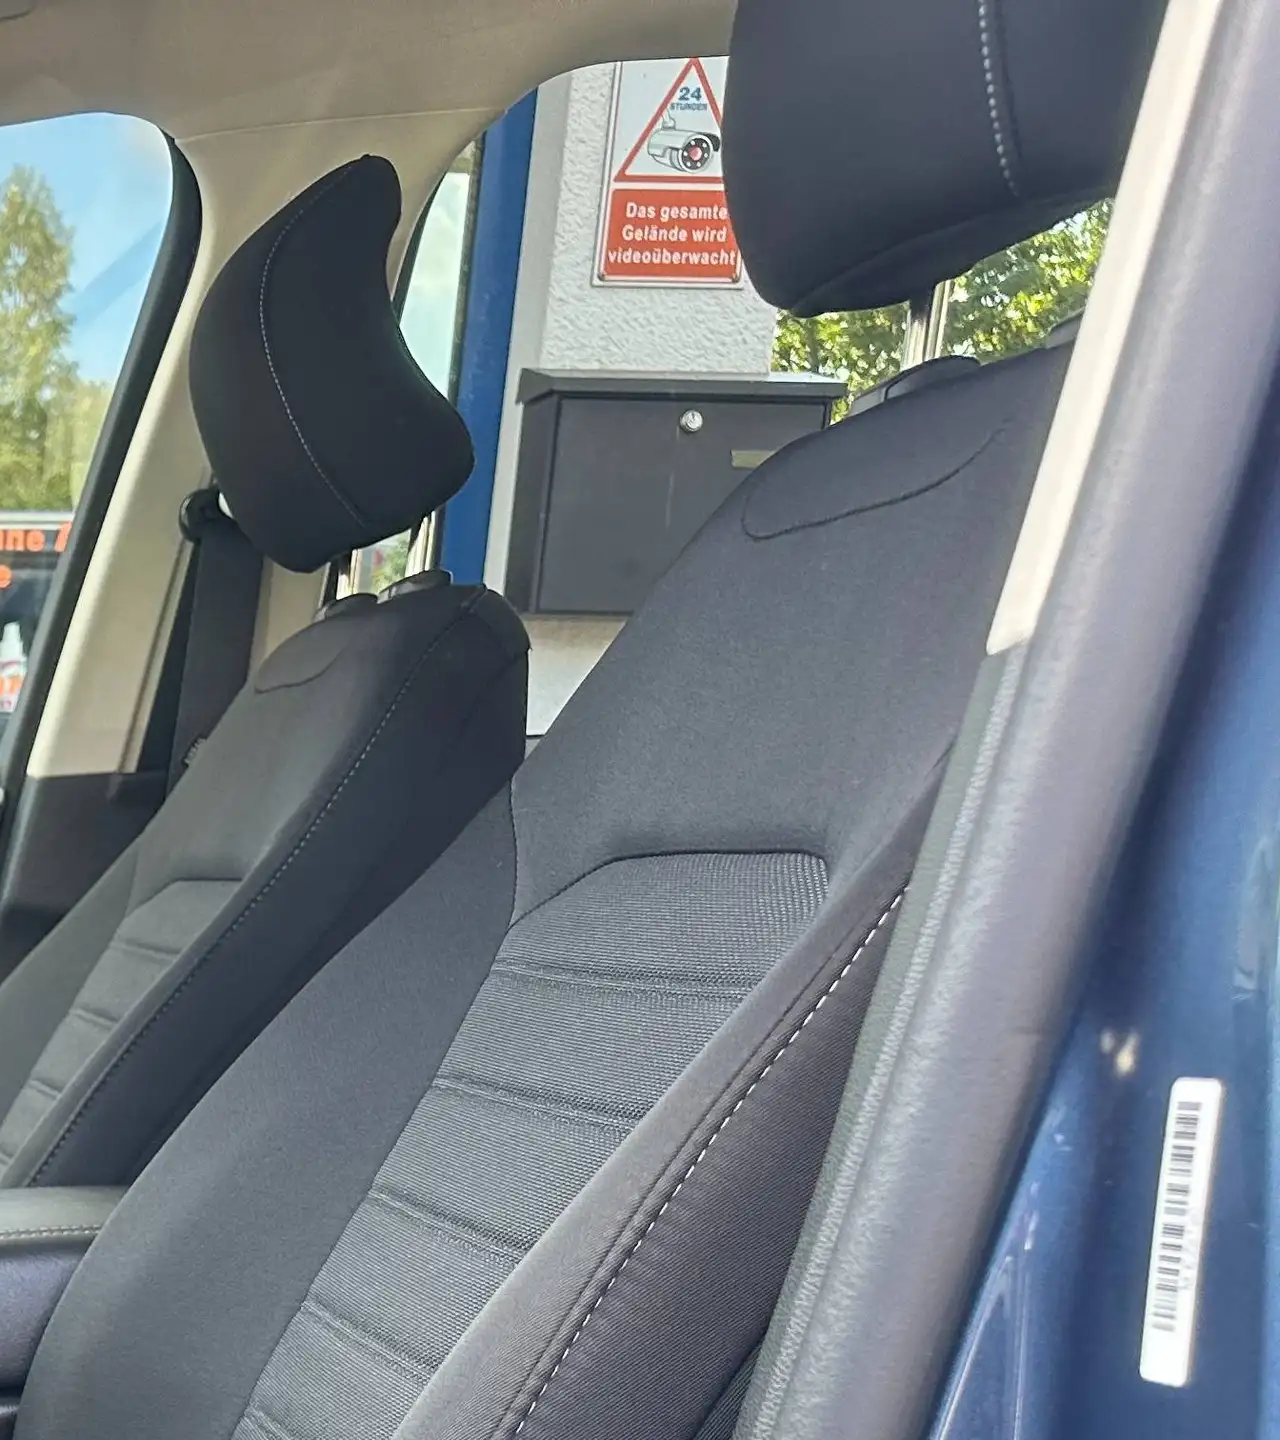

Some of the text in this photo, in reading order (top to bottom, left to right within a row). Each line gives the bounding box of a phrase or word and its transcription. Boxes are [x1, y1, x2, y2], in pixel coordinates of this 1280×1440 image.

[678, 86, 702, 101] 24
[626, 201, 729, 223] Das gesamte
[622, 223, 728, 242] Gelände wird
[608, 247, 737, 266] videoüberwacht
